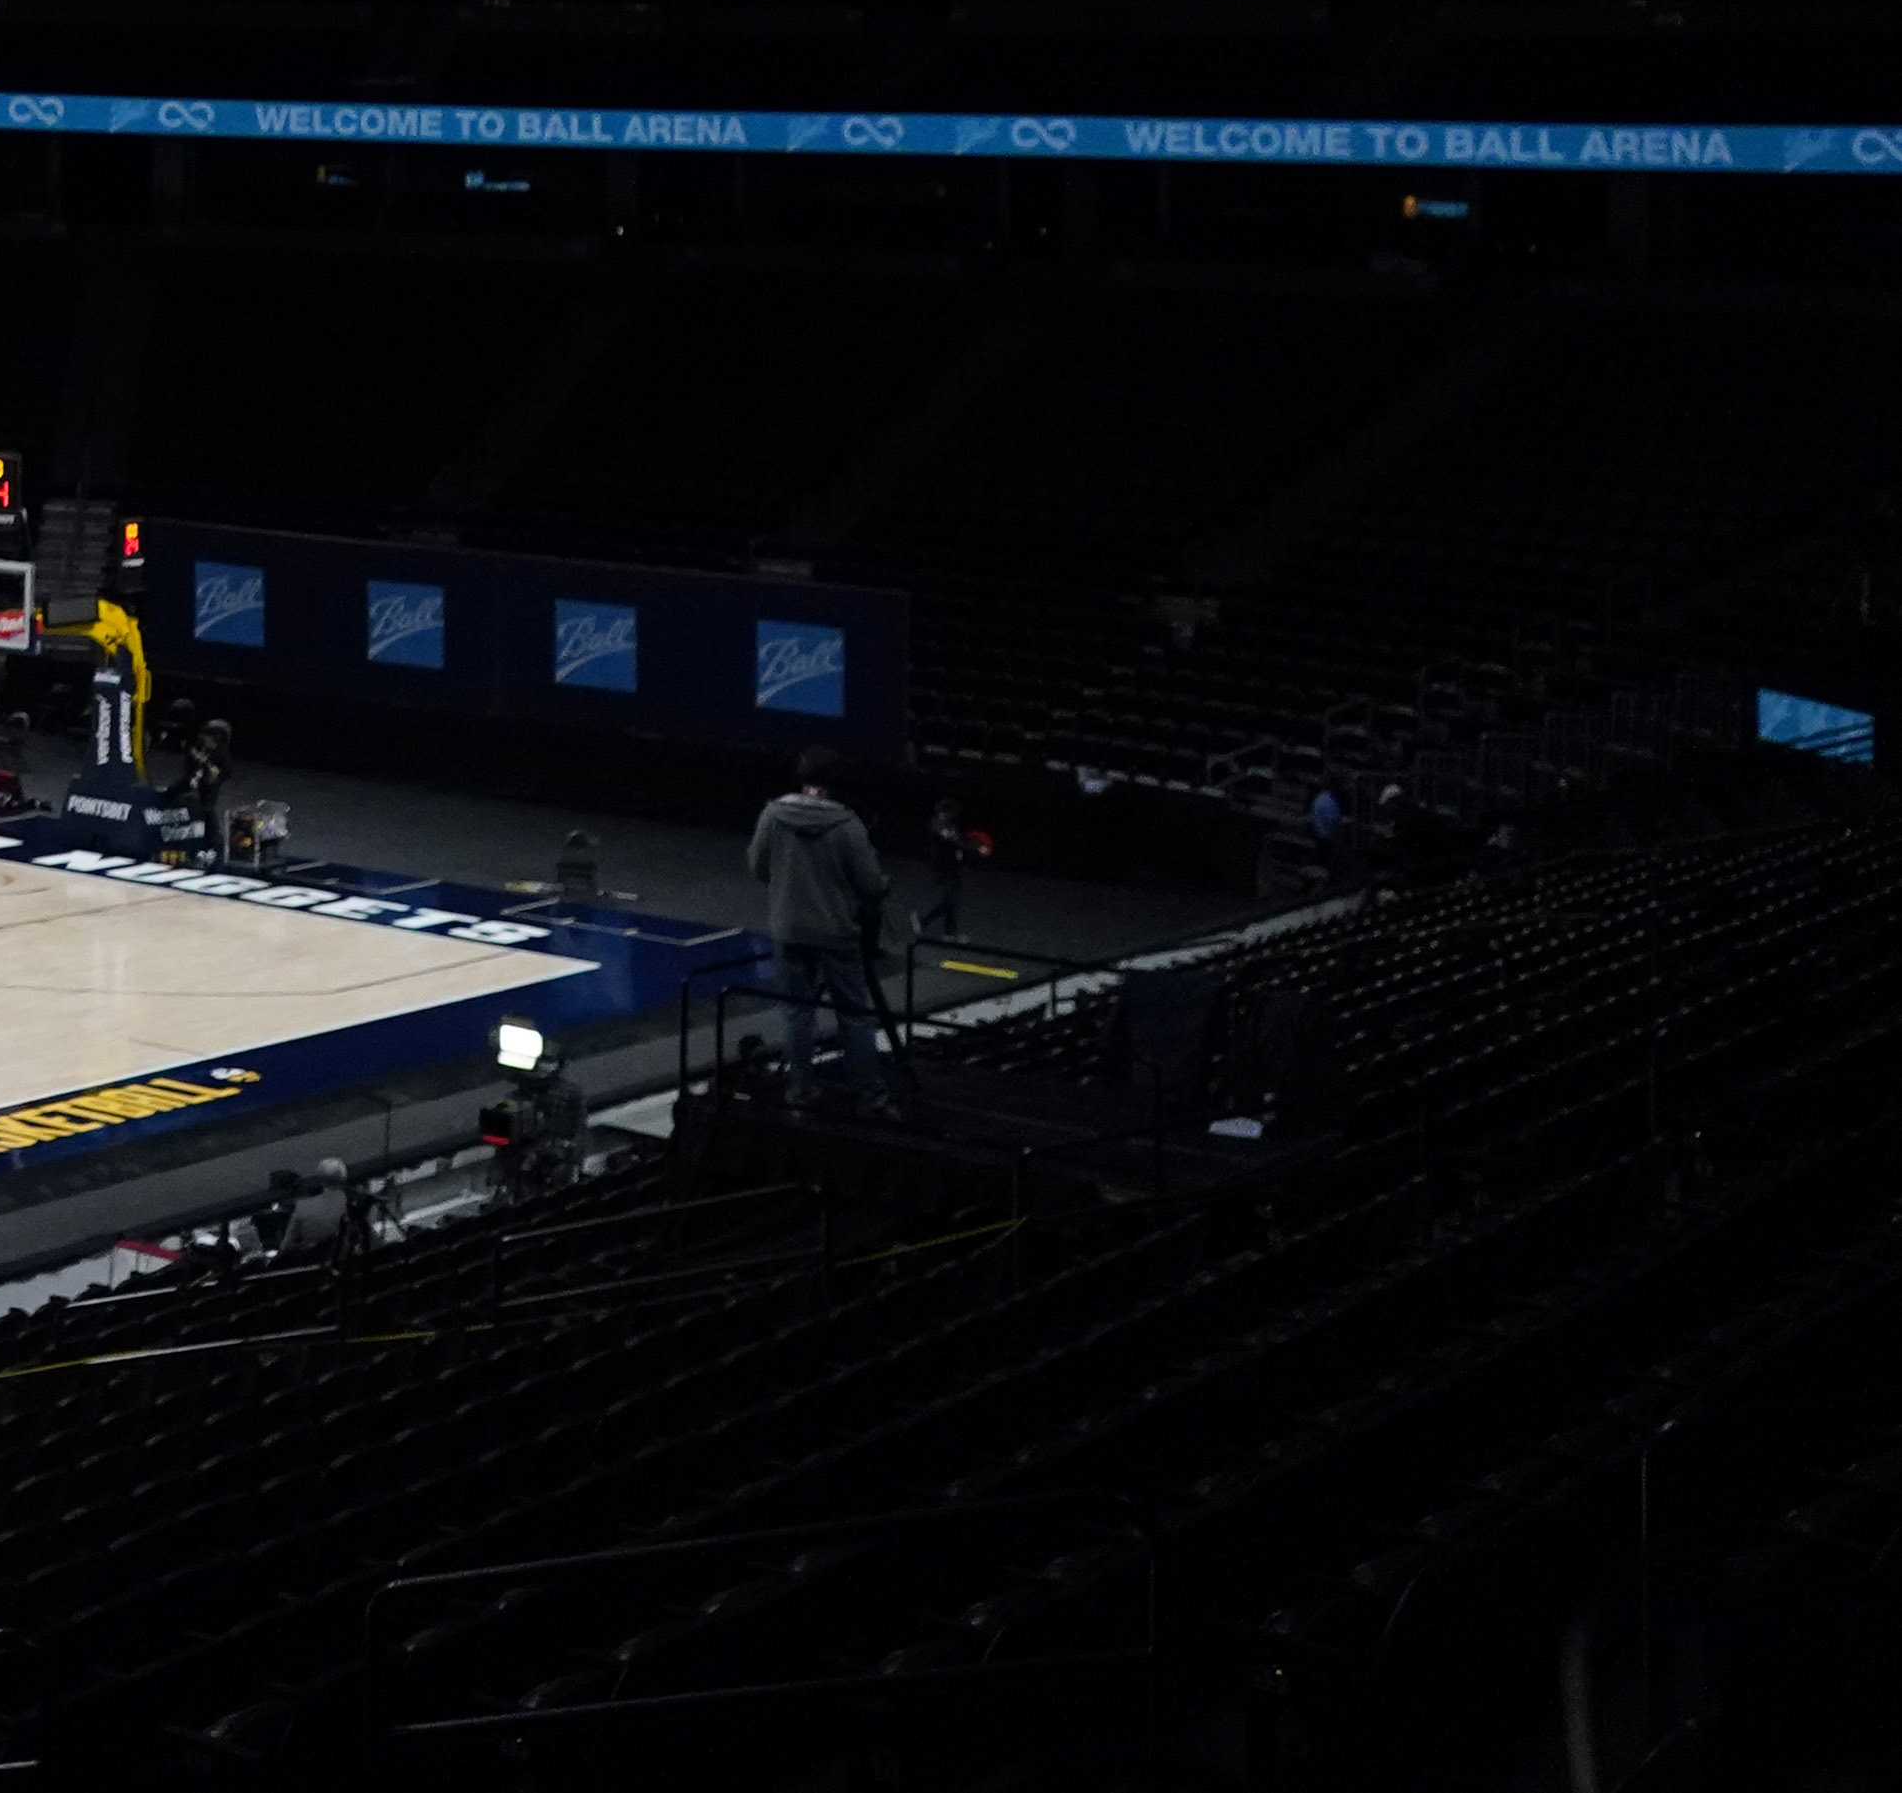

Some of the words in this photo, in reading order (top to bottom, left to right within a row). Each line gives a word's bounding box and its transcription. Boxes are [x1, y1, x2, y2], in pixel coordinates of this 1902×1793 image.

[256, 106, 443, 138] WELCOME
[454, 111, 507, 140] TO
[518, 113, 613, 143] BALL
[623, 115, 747, 145] ARENA
[1126, 120, 1353, 157] WELCOME
[1369, 126, 1428, 159] TO
[1446, 126, 1568, 162] BALL
[1579, 129, 1733, 165] ARENA
[31, 849, 553, 946] NUGGETS
